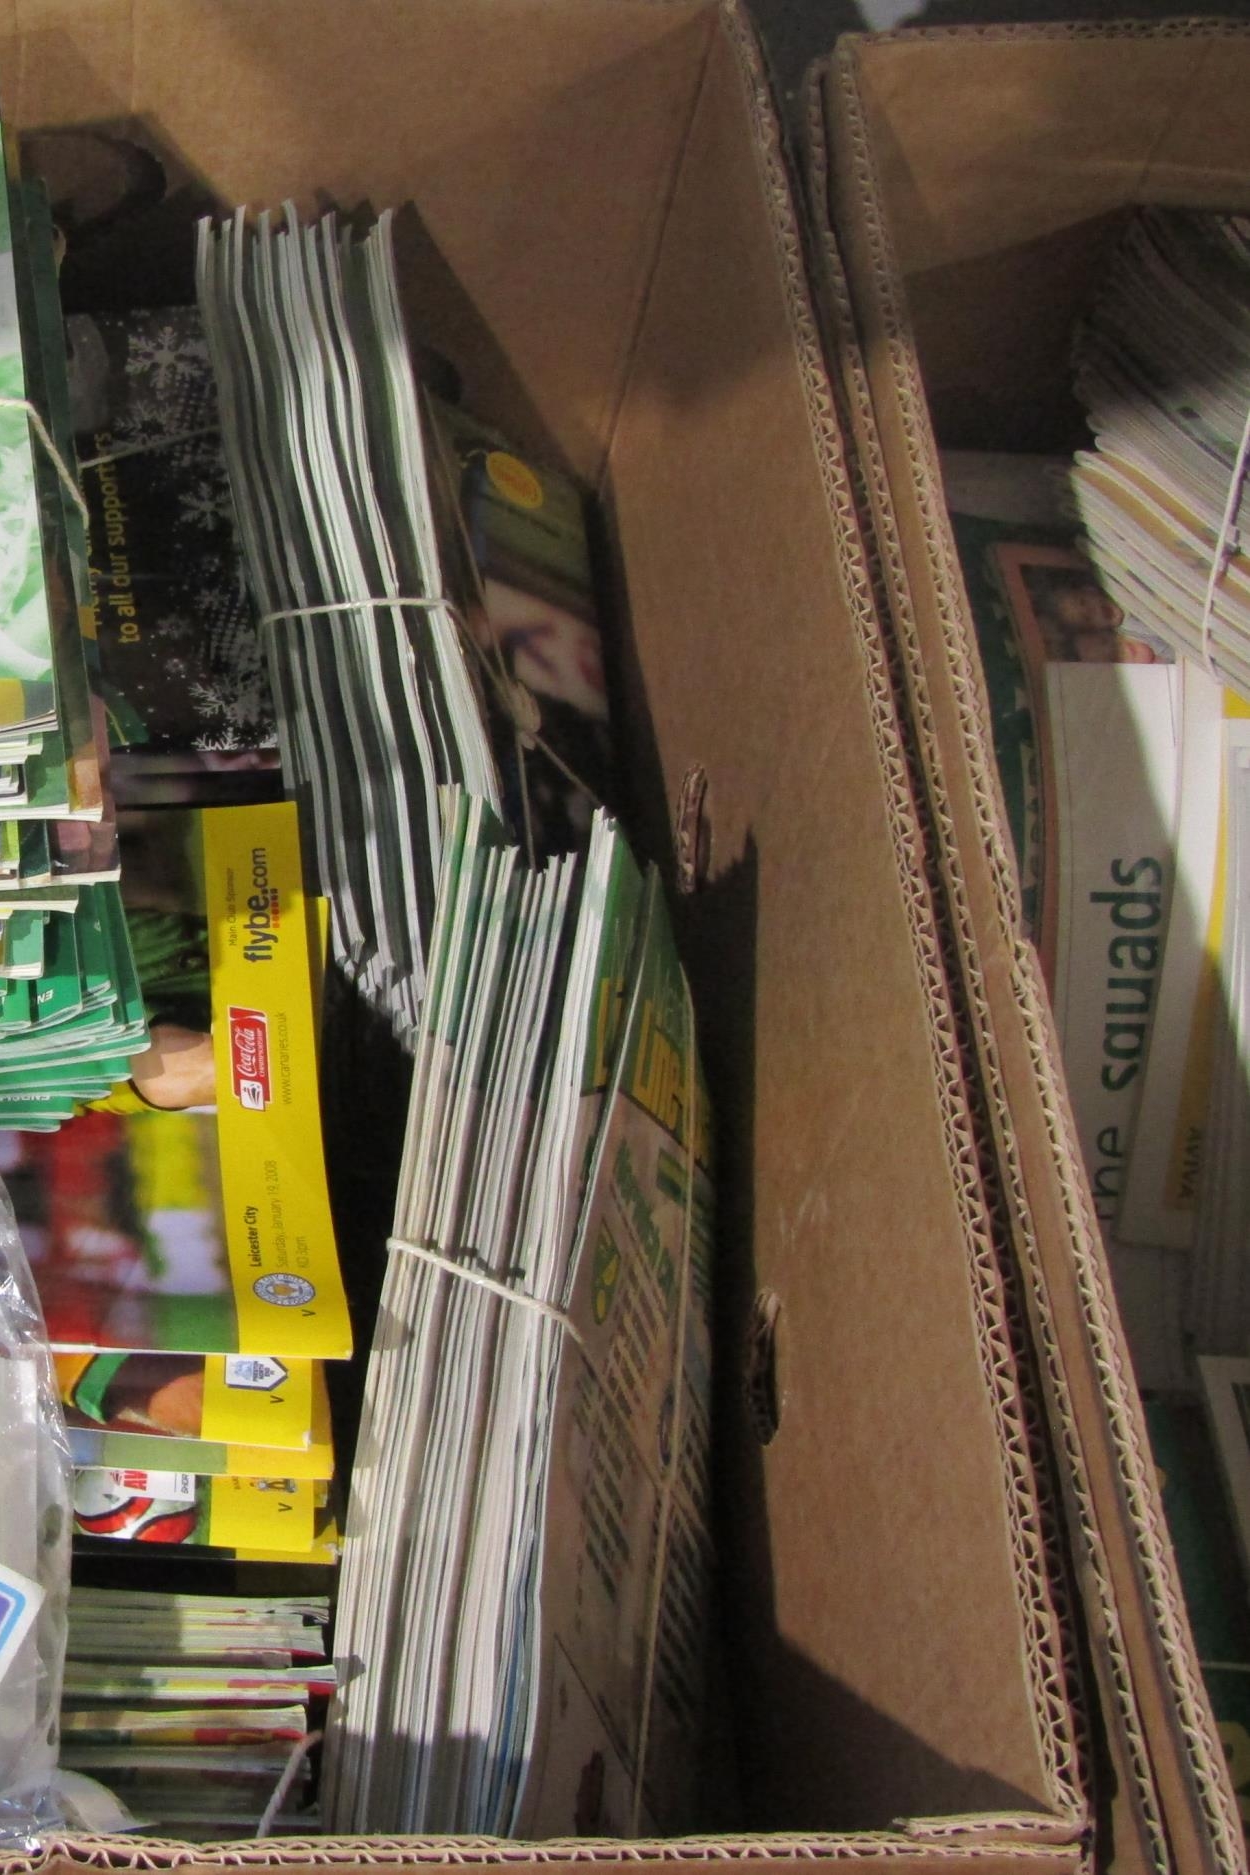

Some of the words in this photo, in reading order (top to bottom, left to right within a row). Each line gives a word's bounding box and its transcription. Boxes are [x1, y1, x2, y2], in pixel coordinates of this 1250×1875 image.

[109, 553, 131, 588] our
[109, 592, 136, 617] all
[117, 623, 140, 645] to
[243, 847, 279, 963] flybe.com
[1089, 857, 1164, 1092] squads
[242, 1205, 259, 1226] City
[248, 1226, 263, 1268] Leicester
